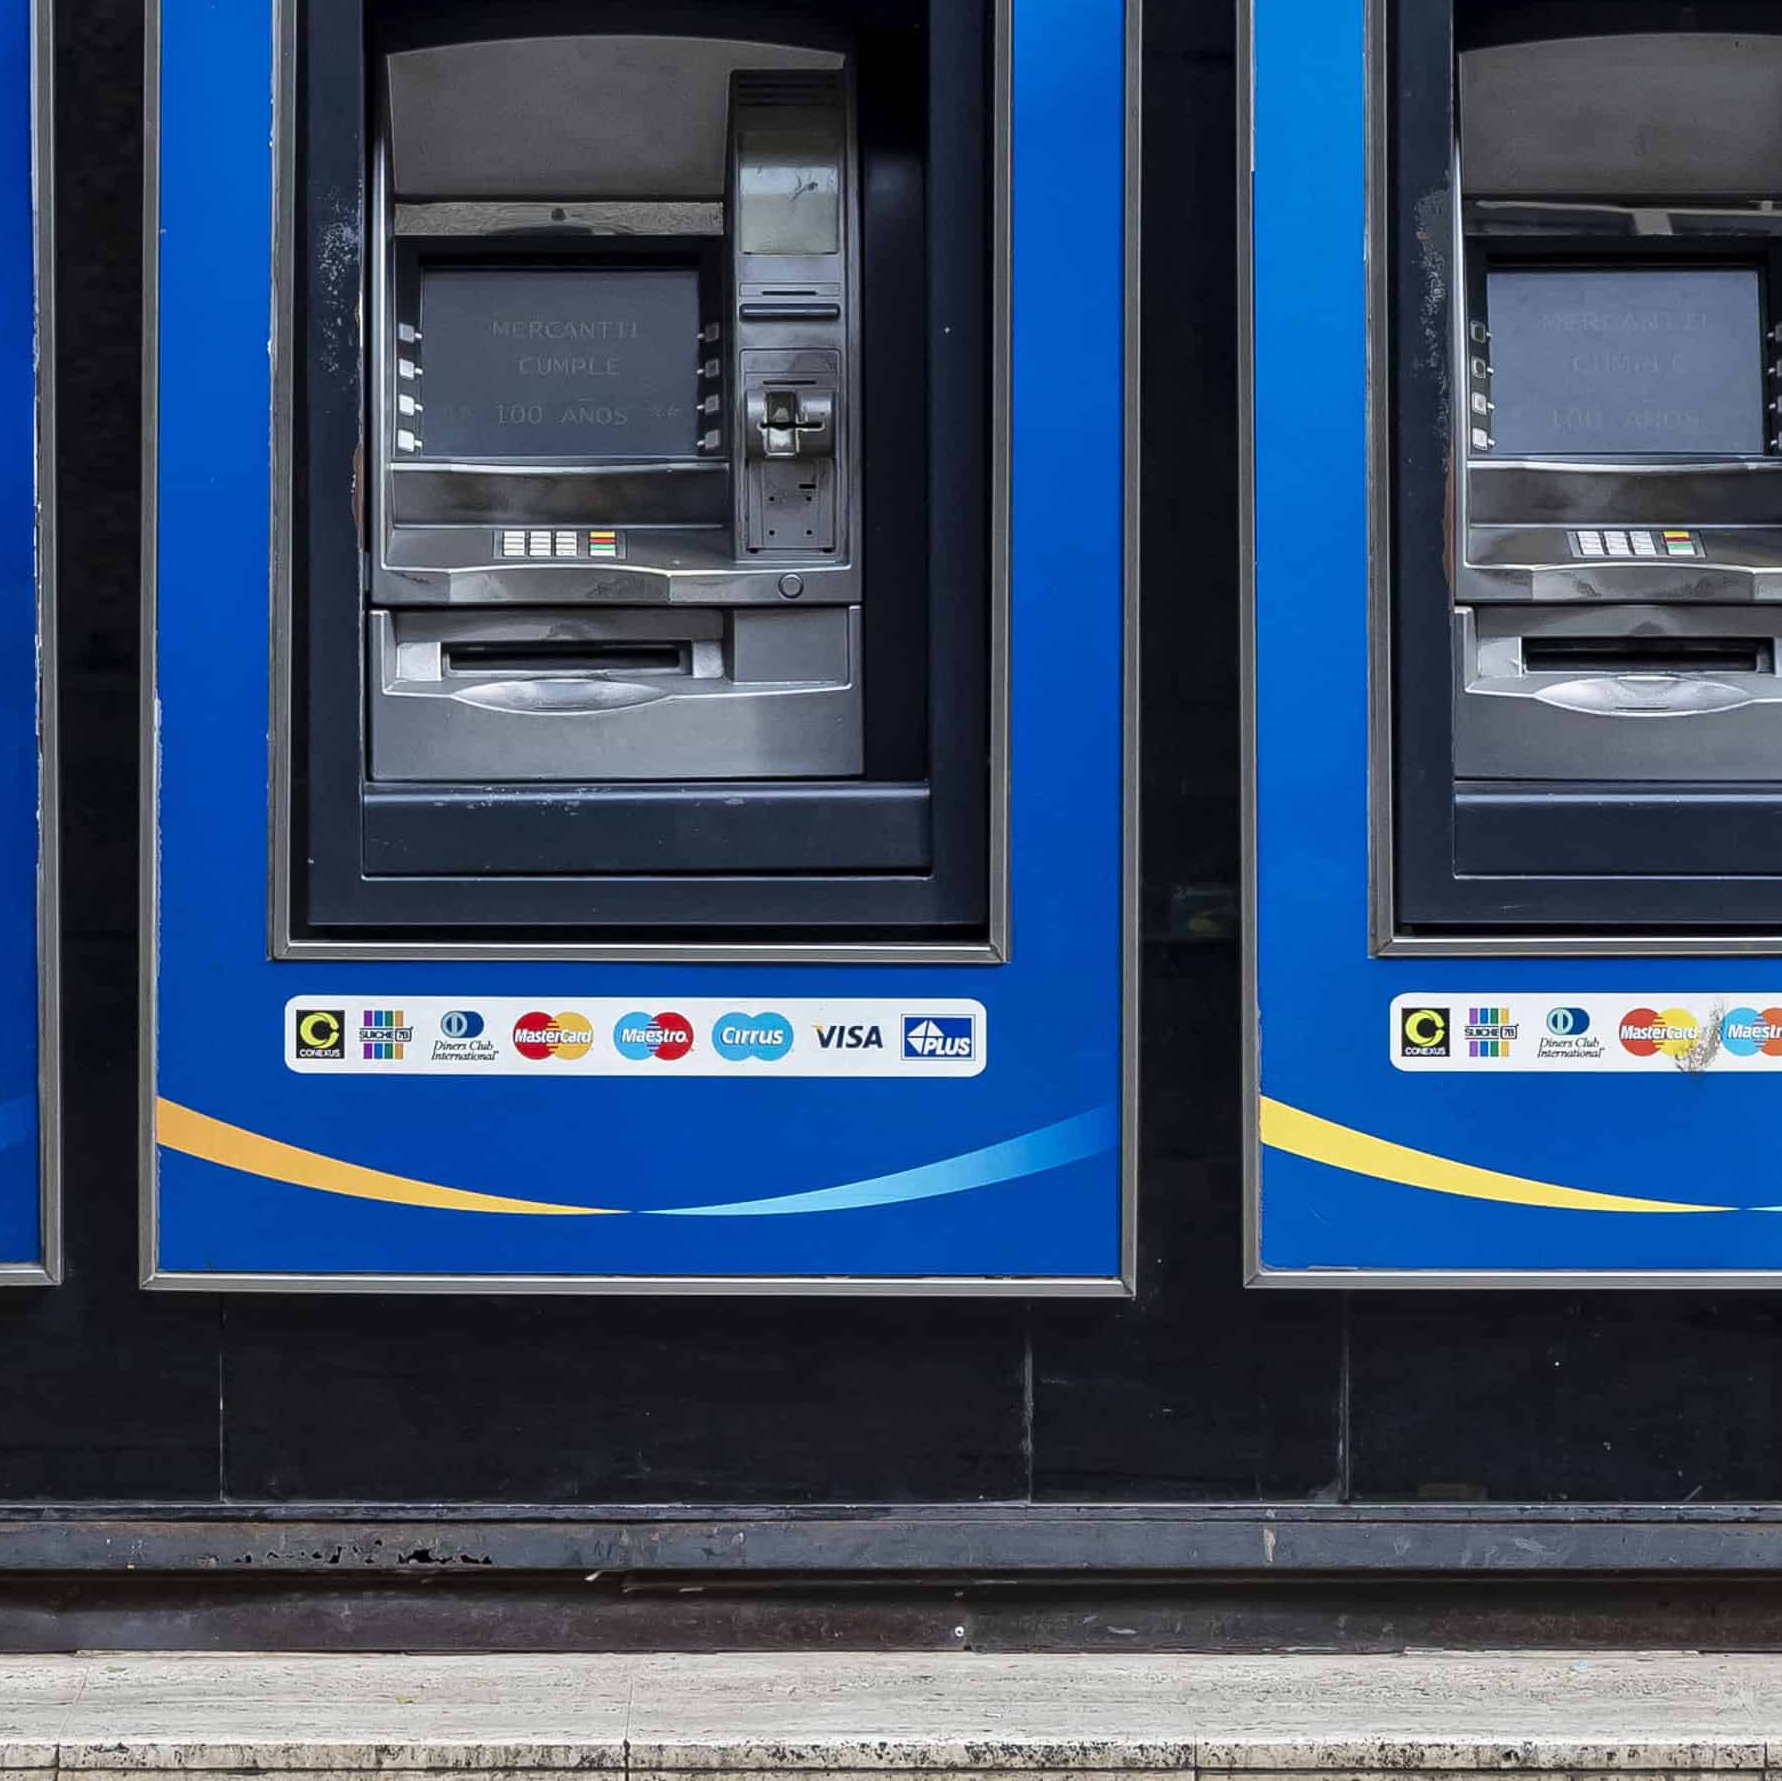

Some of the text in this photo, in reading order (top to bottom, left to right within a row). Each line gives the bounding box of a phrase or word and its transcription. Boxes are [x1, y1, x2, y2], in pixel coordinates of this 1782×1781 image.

[496, 403, 544, 425] 100
[514, 1027, 594, 1044] MasterCard
[621, 1026, 687, 1043] Maestro
[721, 1026, 784, 1046] Cirrus
[813, 1024, 884, 1050] VISA
[1620, 1024, 1699, 1041] MasterCard
[434, 1040, 494, 1051] Diners Club
[923, 1036, 971, 1056] PLUS
[1539, 1036, 1600, 1048] Diners Club
